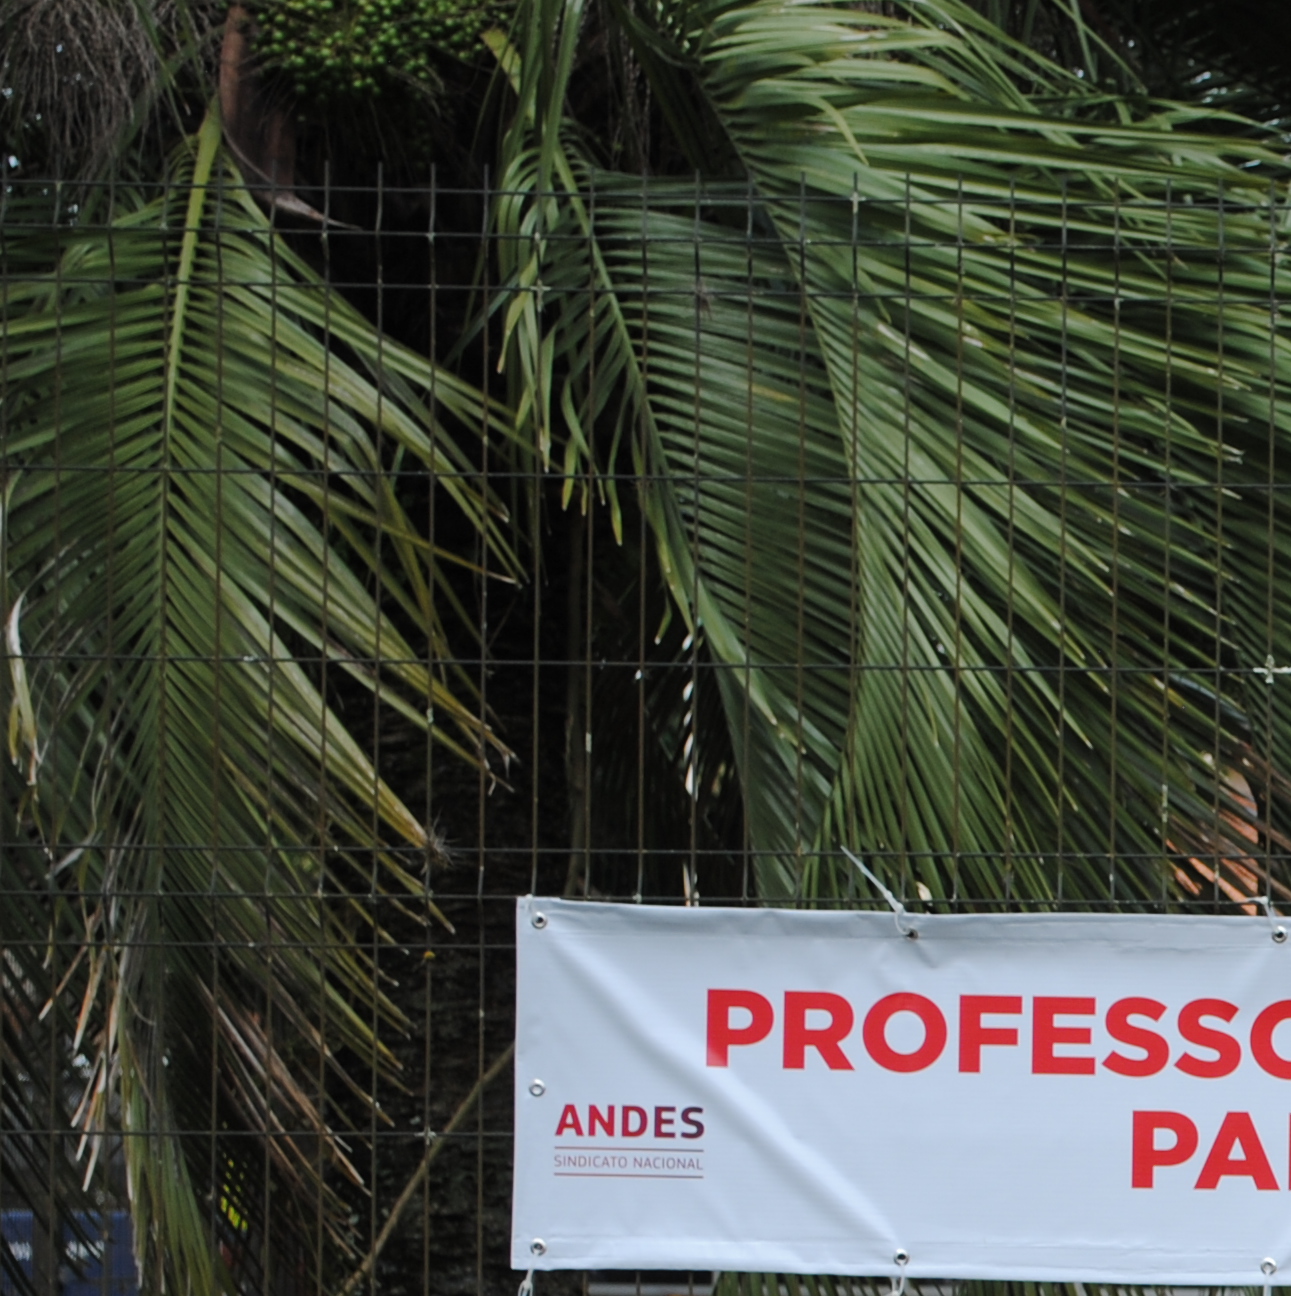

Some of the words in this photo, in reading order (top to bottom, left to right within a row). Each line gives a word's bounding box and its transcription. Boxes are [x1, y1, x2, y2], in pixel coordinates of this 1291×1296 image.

[555, 1103, 705, 1139] ANDES
[554, 1154, 628, 1168] SINDICATO
[633, 1156, 703, 1170] NACIONAL
